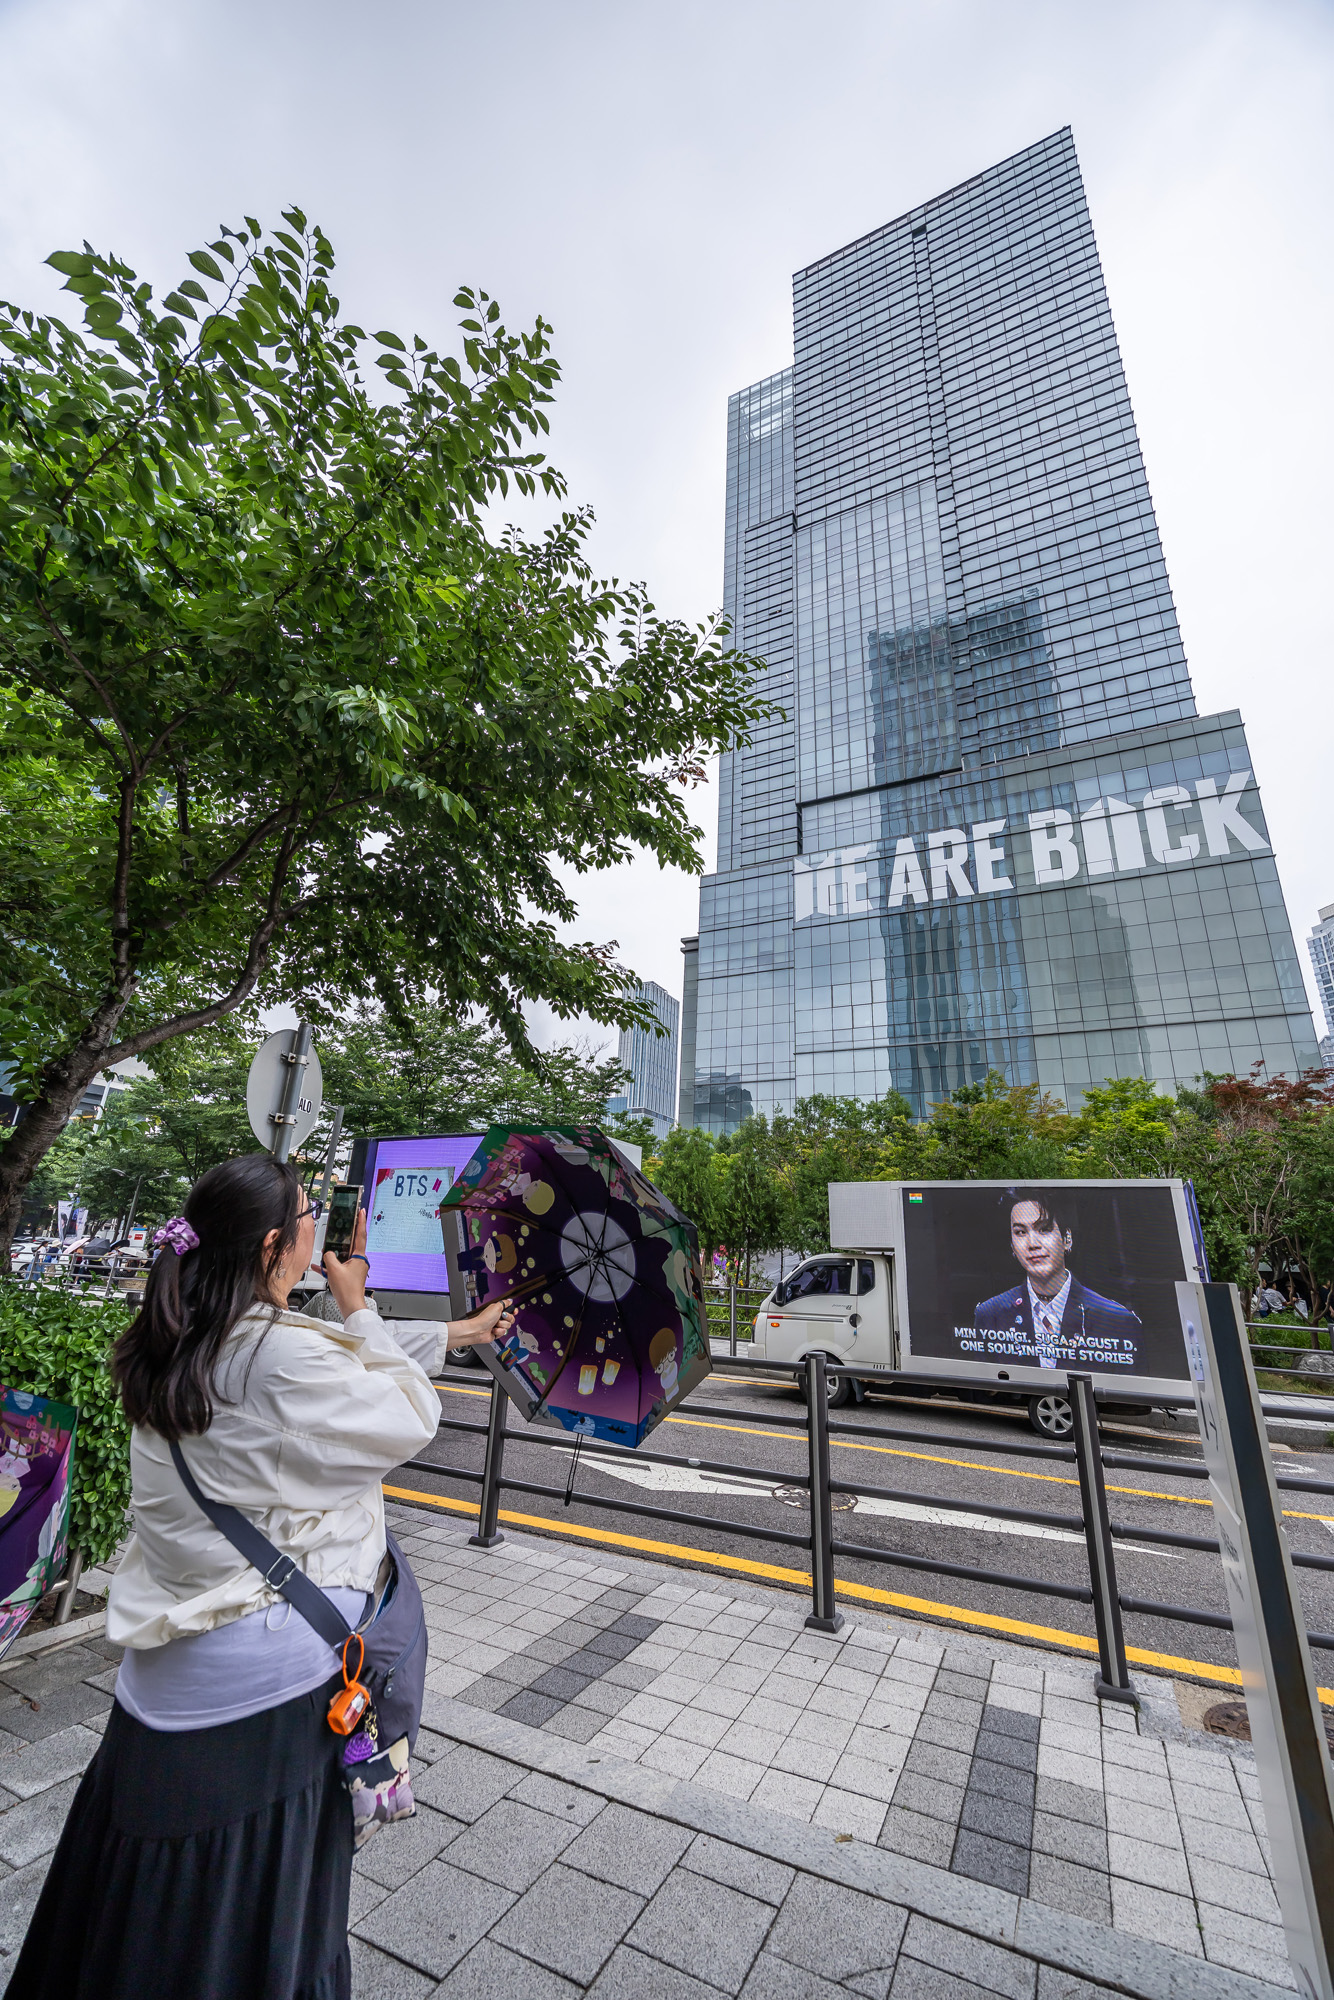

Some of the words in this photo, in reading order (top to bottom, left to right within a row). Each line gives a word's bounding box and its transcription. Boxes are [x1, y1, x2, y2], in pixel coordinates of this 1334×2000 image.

[887, 819, 1014, 907] ARE
[394, 1175, 428, 1197] BTS
[954, 1327, 976, 1339] MIN
[979, 1329, 1031, 1343] YOONGI.
[1077, 1336, 1119, 1350] AGUST
[1123, 1340, 1138, 1352] D.
[960, 1340, 985, 1352] ONE
[1021, 1344, 1077, 1360] INFINITE
[1079, 1349, 1134, 1365] STORIES
